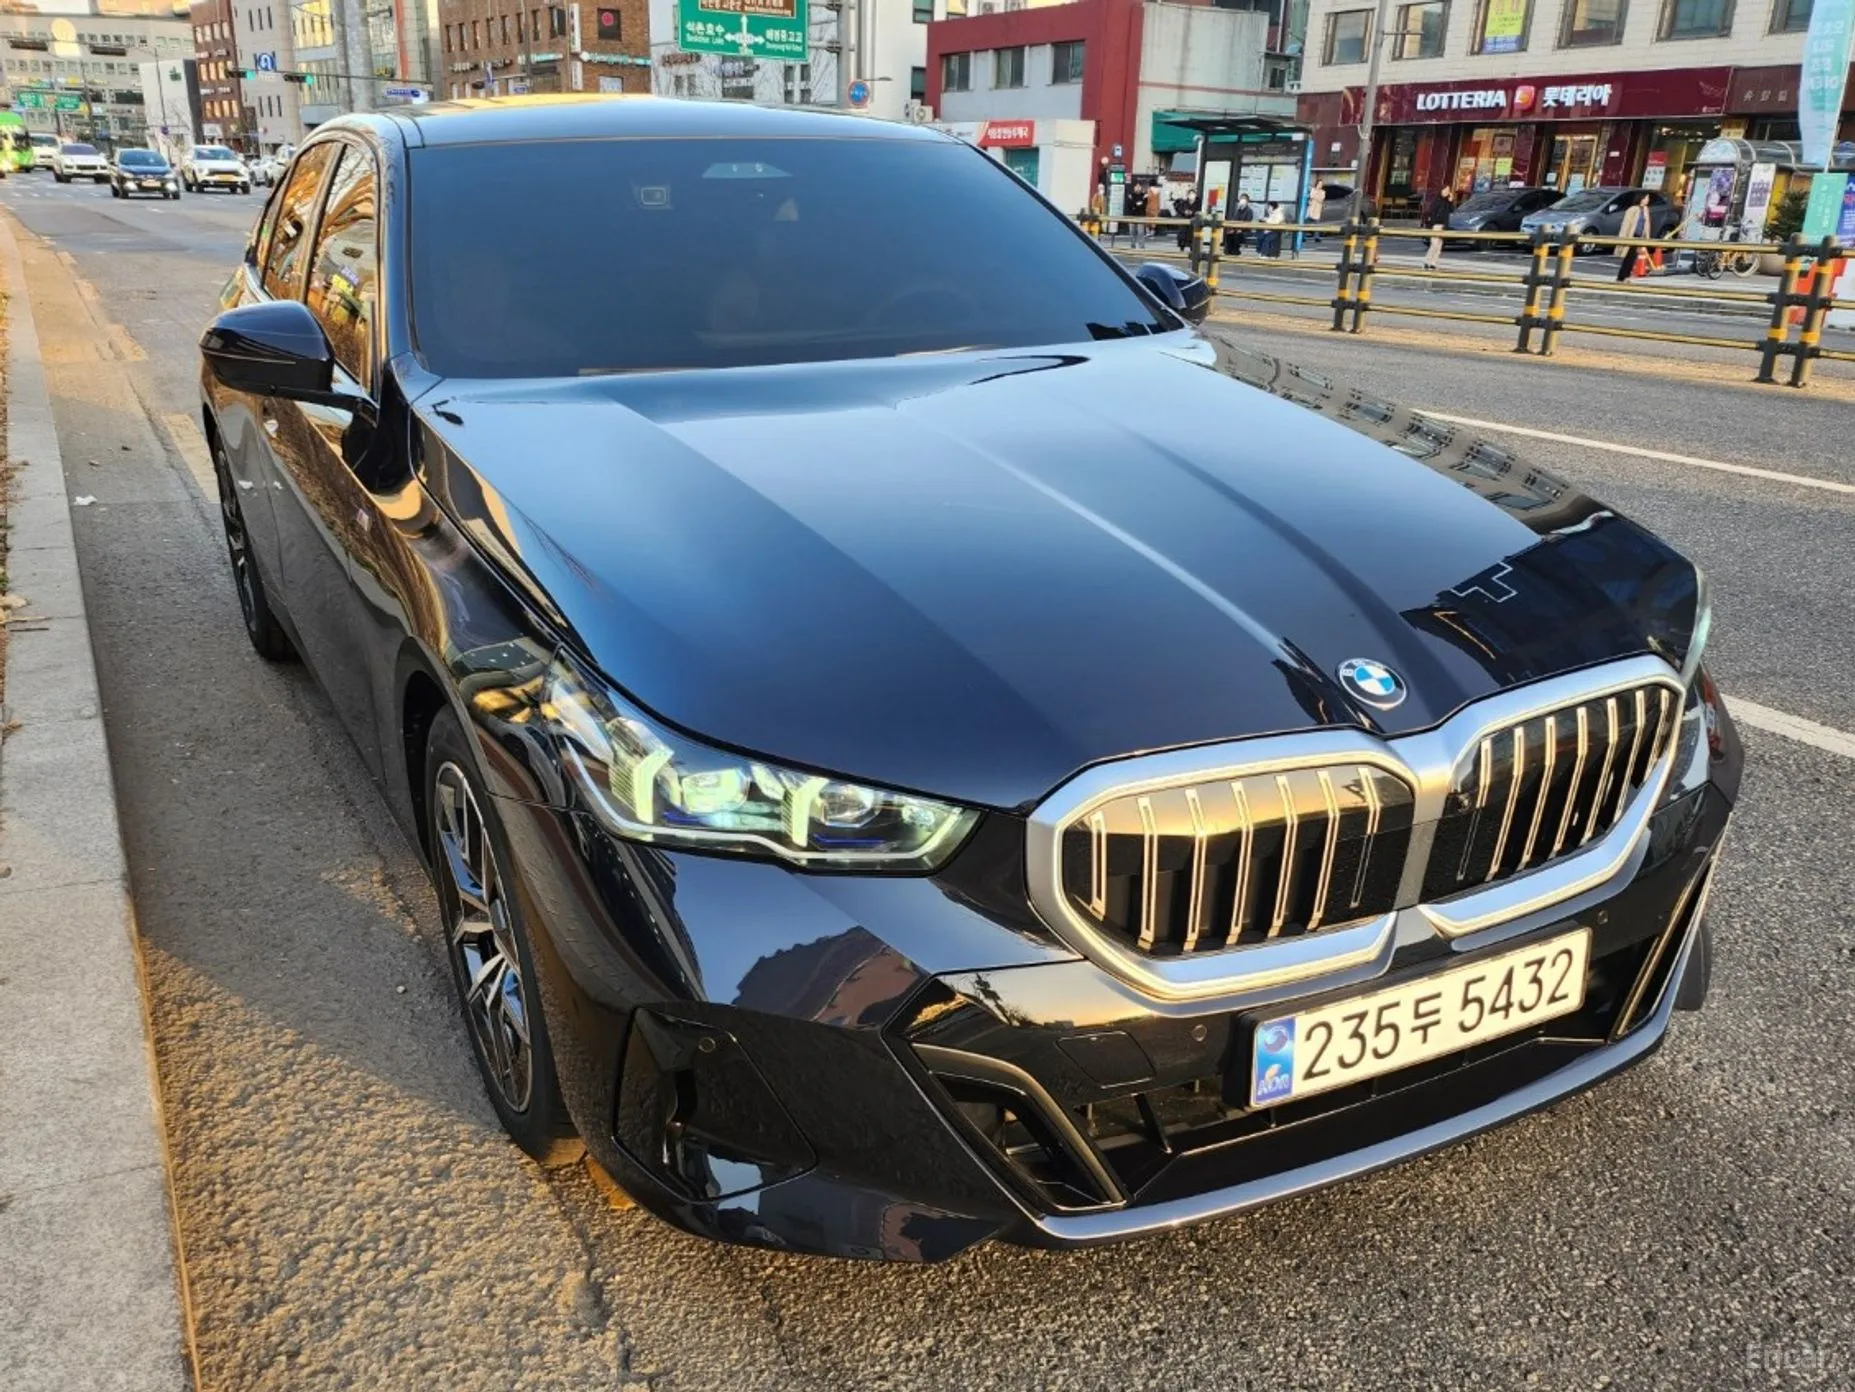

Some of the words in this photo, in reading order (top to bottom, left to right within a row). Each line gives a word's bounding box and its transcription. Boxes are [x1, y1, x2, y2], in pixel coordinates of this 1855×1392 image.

[1416, 89, 1507, 111] LOTTERIA
[1542, 84, 1613, 108] 롯데리아
[1302, 991, 1443, 1081] 235두
[1458, 947, 1574, 1034] 5432
